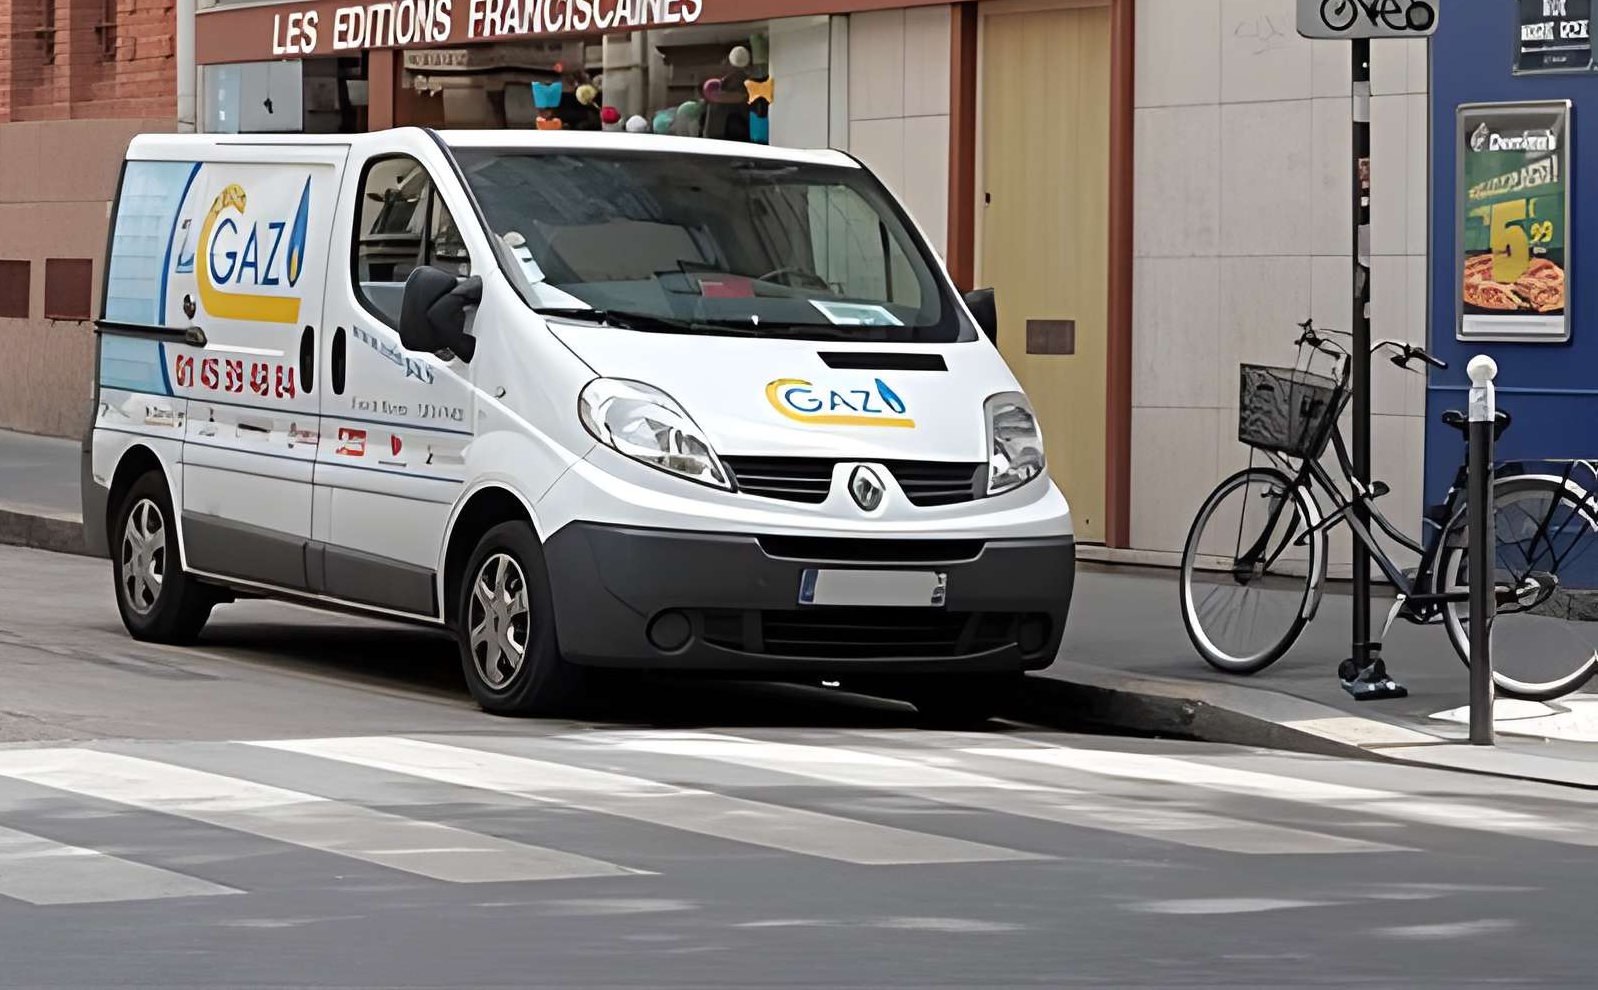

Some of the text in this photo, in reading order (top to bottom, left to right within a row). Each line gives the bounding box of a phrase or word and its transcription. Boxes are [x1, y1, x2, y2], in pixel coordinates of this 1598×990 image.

[273, 10, 319, 55] LES
[209, 218, 286, 286] GAZ
[784, 388, 882, 413] GAZ
